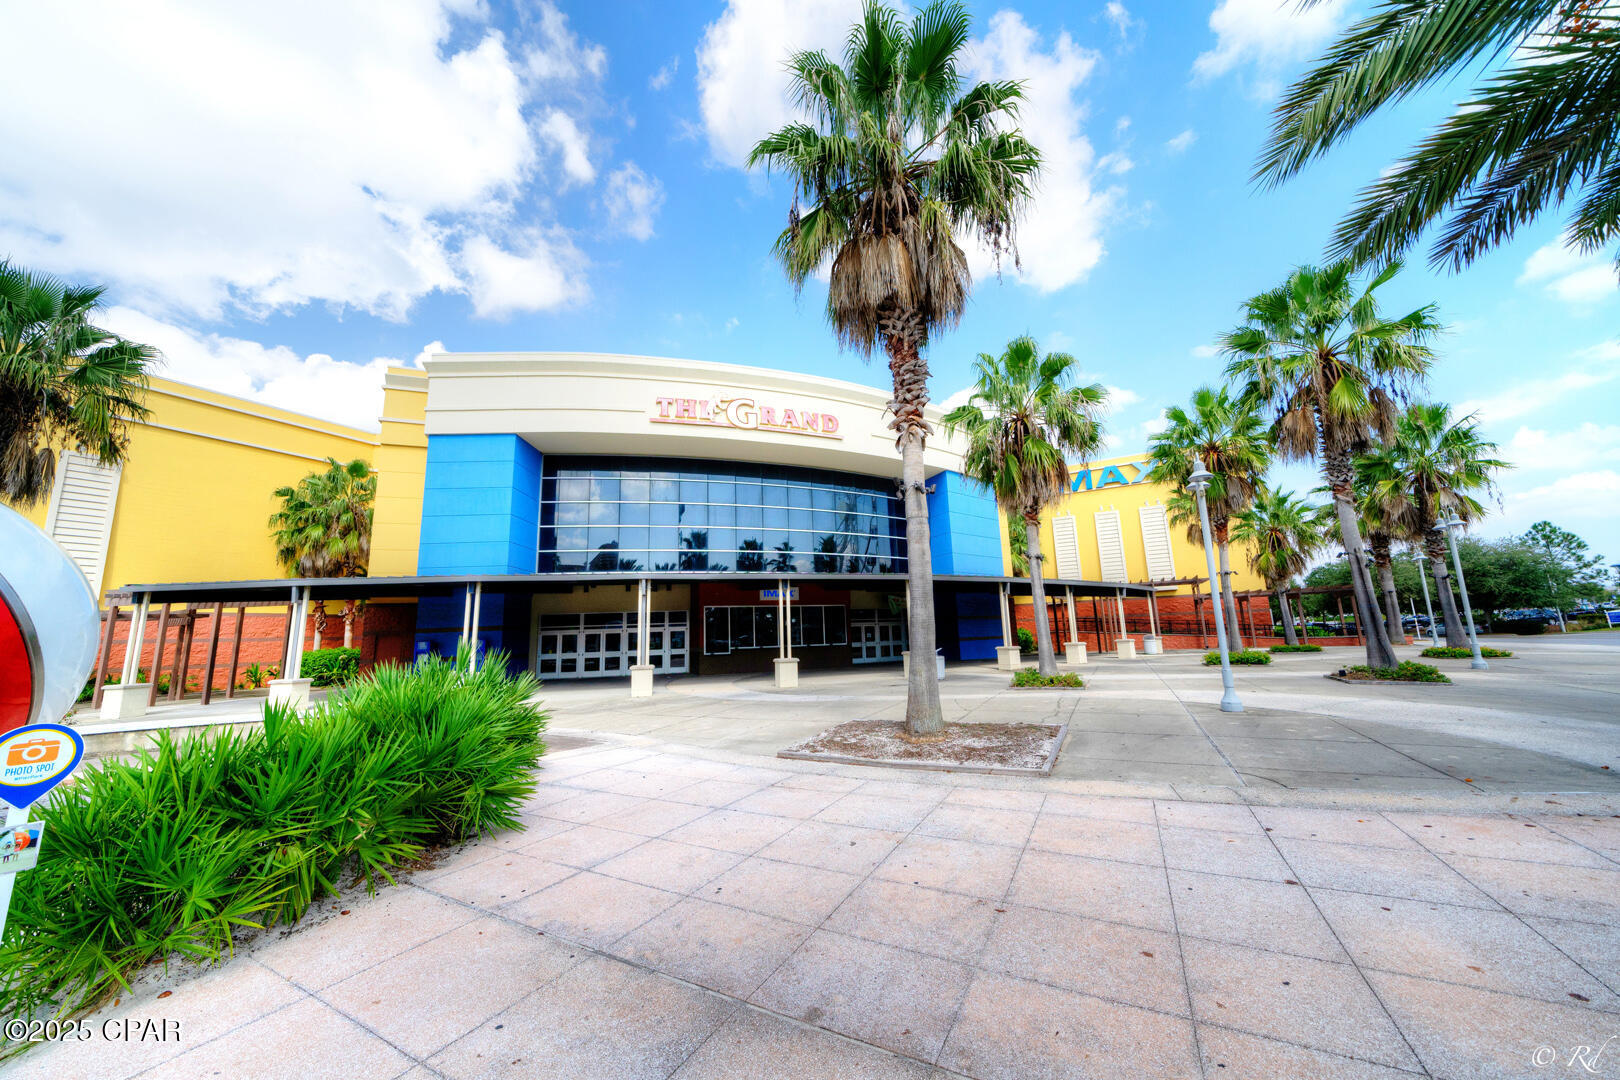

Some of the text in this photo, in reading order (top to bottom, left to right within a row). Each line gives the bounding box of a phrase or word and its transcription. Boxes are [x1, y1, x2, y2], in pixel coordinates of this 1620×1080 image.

[726, 398, 839, 433] GRAND
[1059, 459, 1160, 492] MAX
[5, 762, 56, 777] PHOTO SPOT
